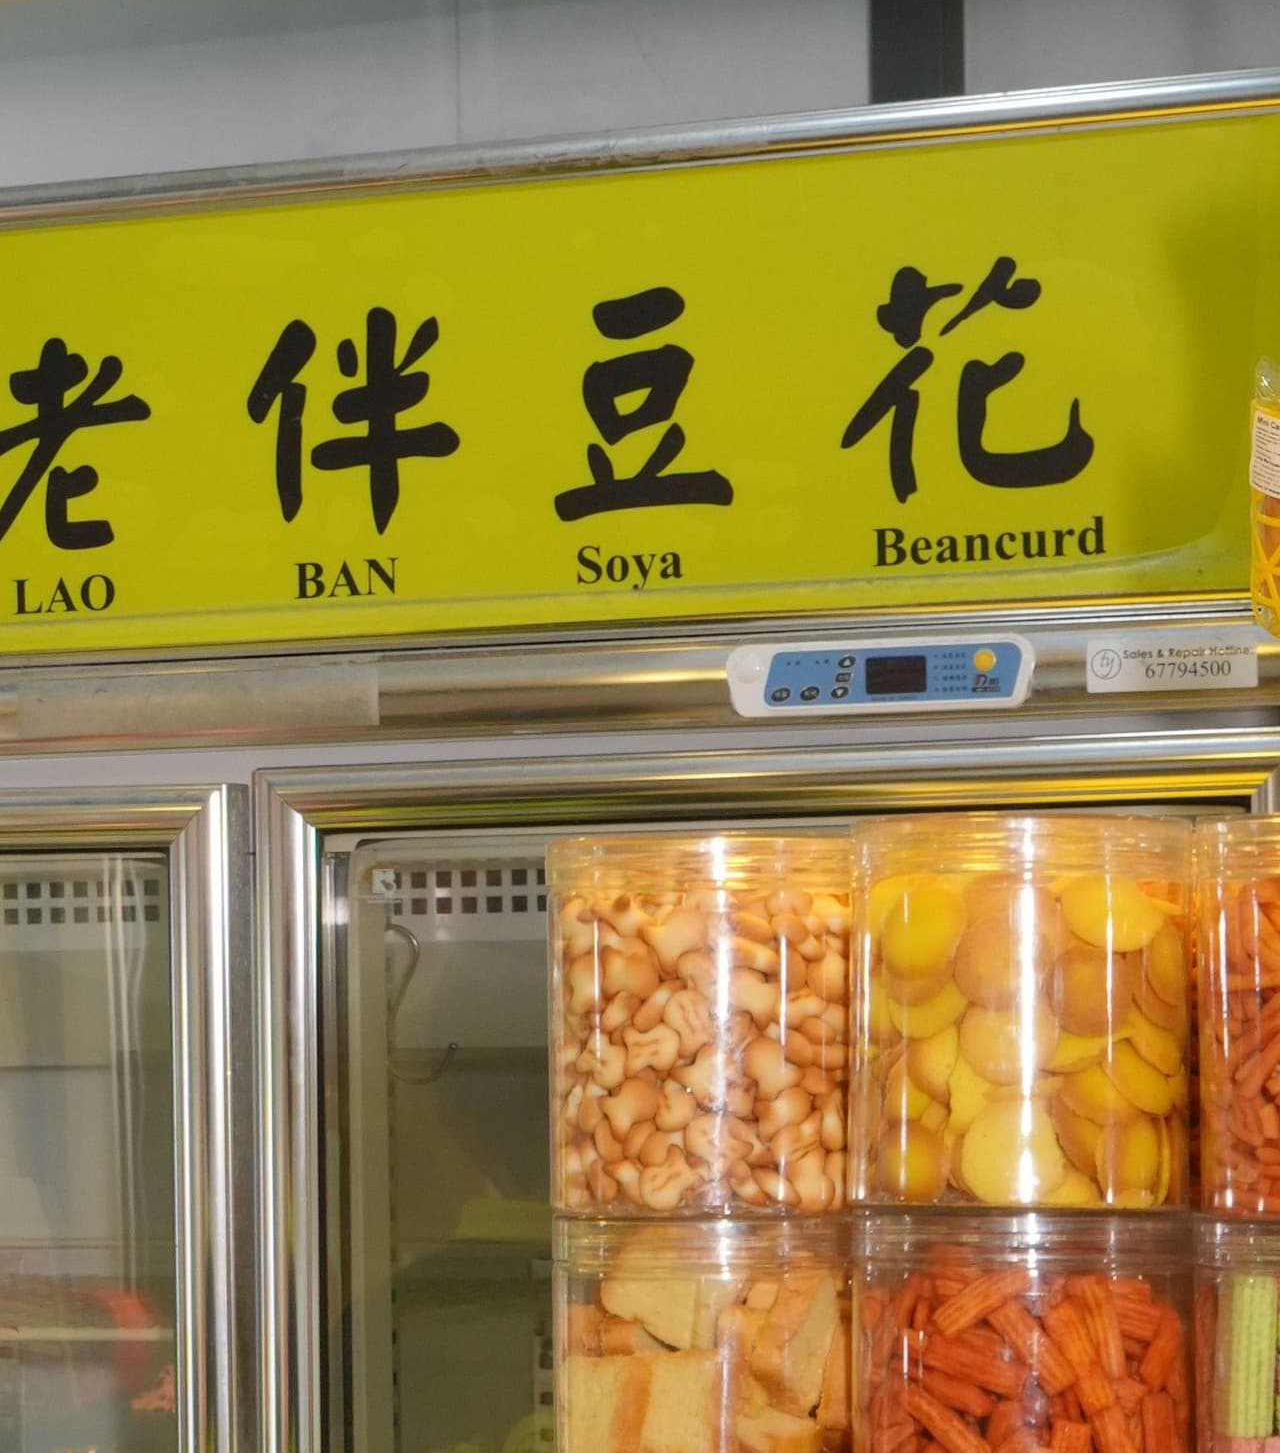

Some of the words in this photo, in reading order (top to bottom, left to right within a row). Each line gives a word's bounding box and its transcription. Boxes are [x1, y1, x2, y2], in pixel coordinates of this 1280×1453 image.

[14, 574, 116, 615] LAO
[295, 556, 400, 600] BAN
[576, 543, 683, 593] Soya
[872, 515, 1107, 568] Beancurd
[1123, 649, 1153, 659] Sales
[1145, 660, 1231, 679] 67794500
